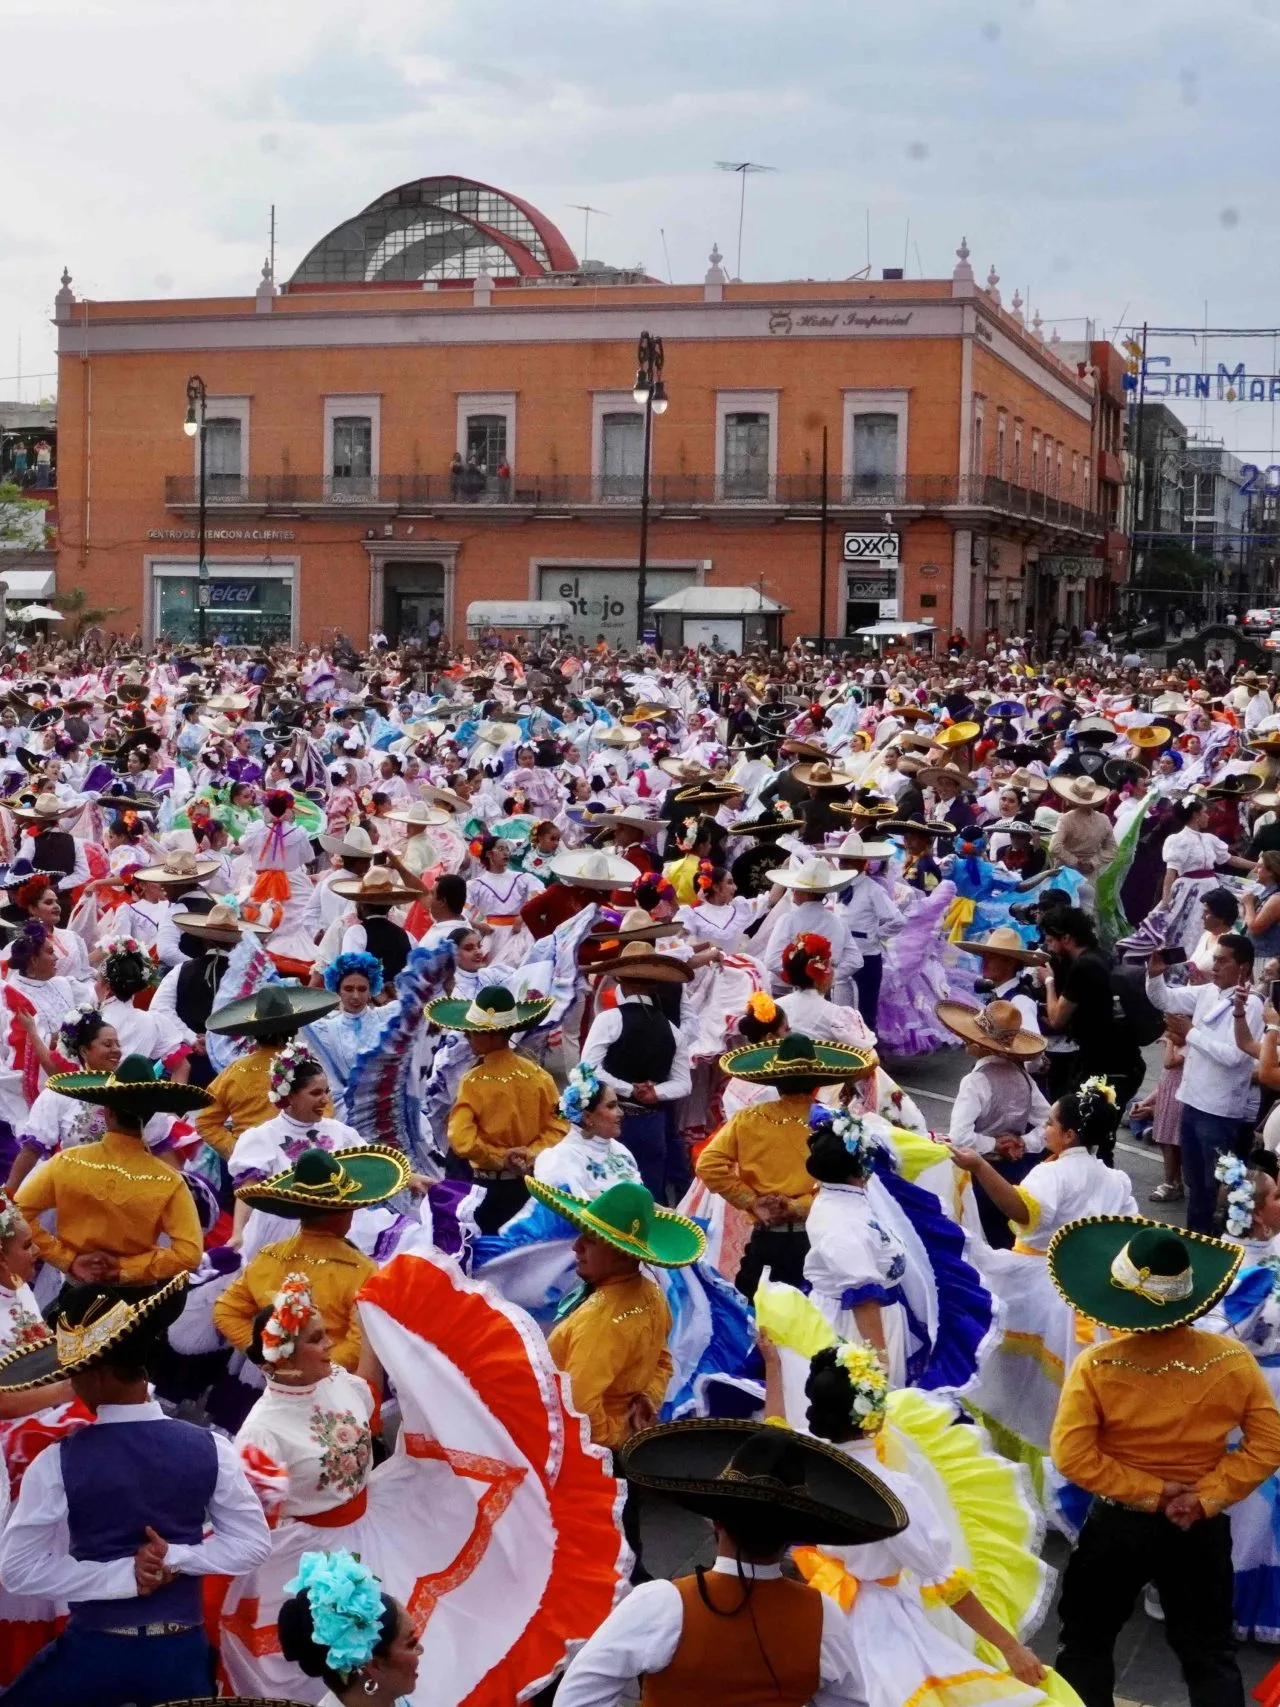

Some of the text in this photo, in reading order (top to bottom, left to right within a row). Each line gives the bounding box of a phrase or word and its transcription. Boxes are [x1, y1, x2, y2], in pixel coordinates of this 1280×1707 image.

[796, 314, 839, 327] Hotel
[843, 312, 913, 328] Imperial
[184, 530, 196, 539] DE
[244, 530, 251, 539] A
[253, 530, 296, 540] CLIENTES
[846, 536, 897, 556] OXXO
[559, 577, 579, 598] el
[568, 594, 624, 621] ntojo
